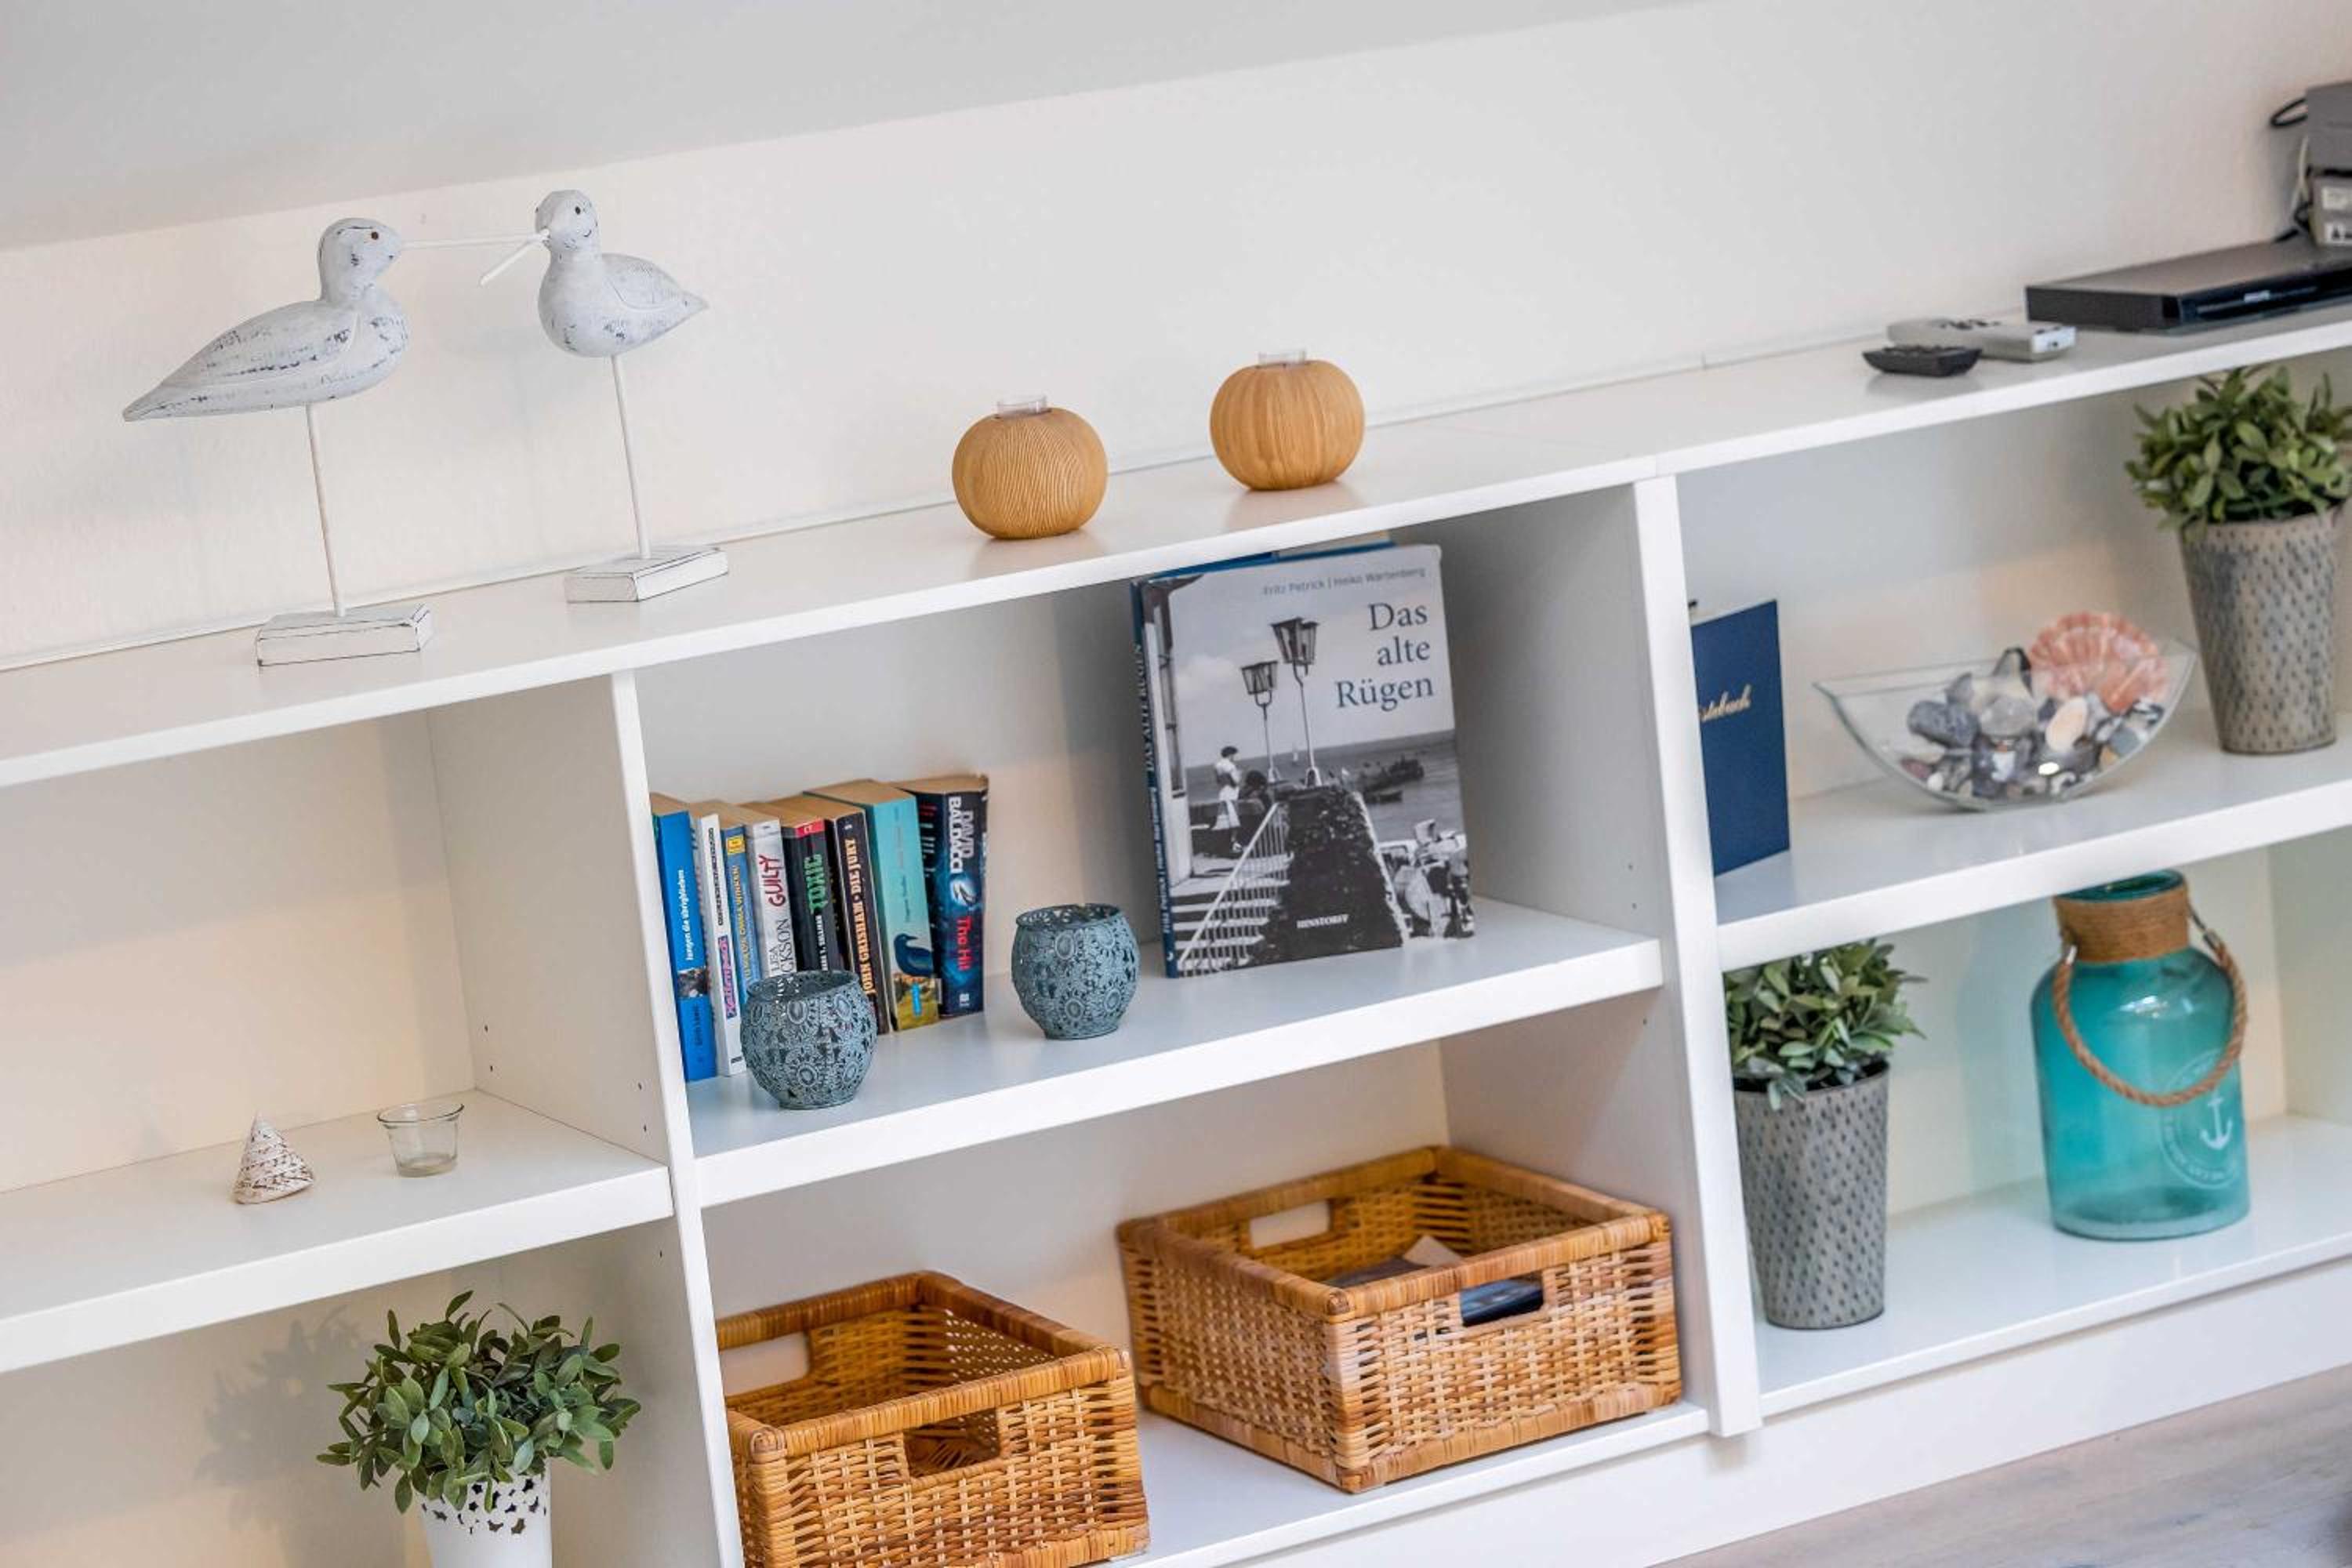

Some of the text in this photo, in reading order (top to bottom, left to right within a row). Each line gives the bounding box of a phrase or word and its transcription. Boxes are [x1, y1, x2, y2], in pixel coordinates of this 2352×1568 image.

[1367, 602, 1428, 631] Das
[1377, 636, 1431, 666] alte
[1336, 677, 1434, 713] Rügen
[948, 796, 964, 874] BALDACCI
[961, 810, 975, 858] DAVID
[758, 855, 787, 908] GUILTY
[804, 853, 829, 915] TOXIC
[844, 838, 877, 996] JOHN GRISHAM DIE JURY
[956, 916, 972, 946] The
[775, 919, 795, 974] CKSON
